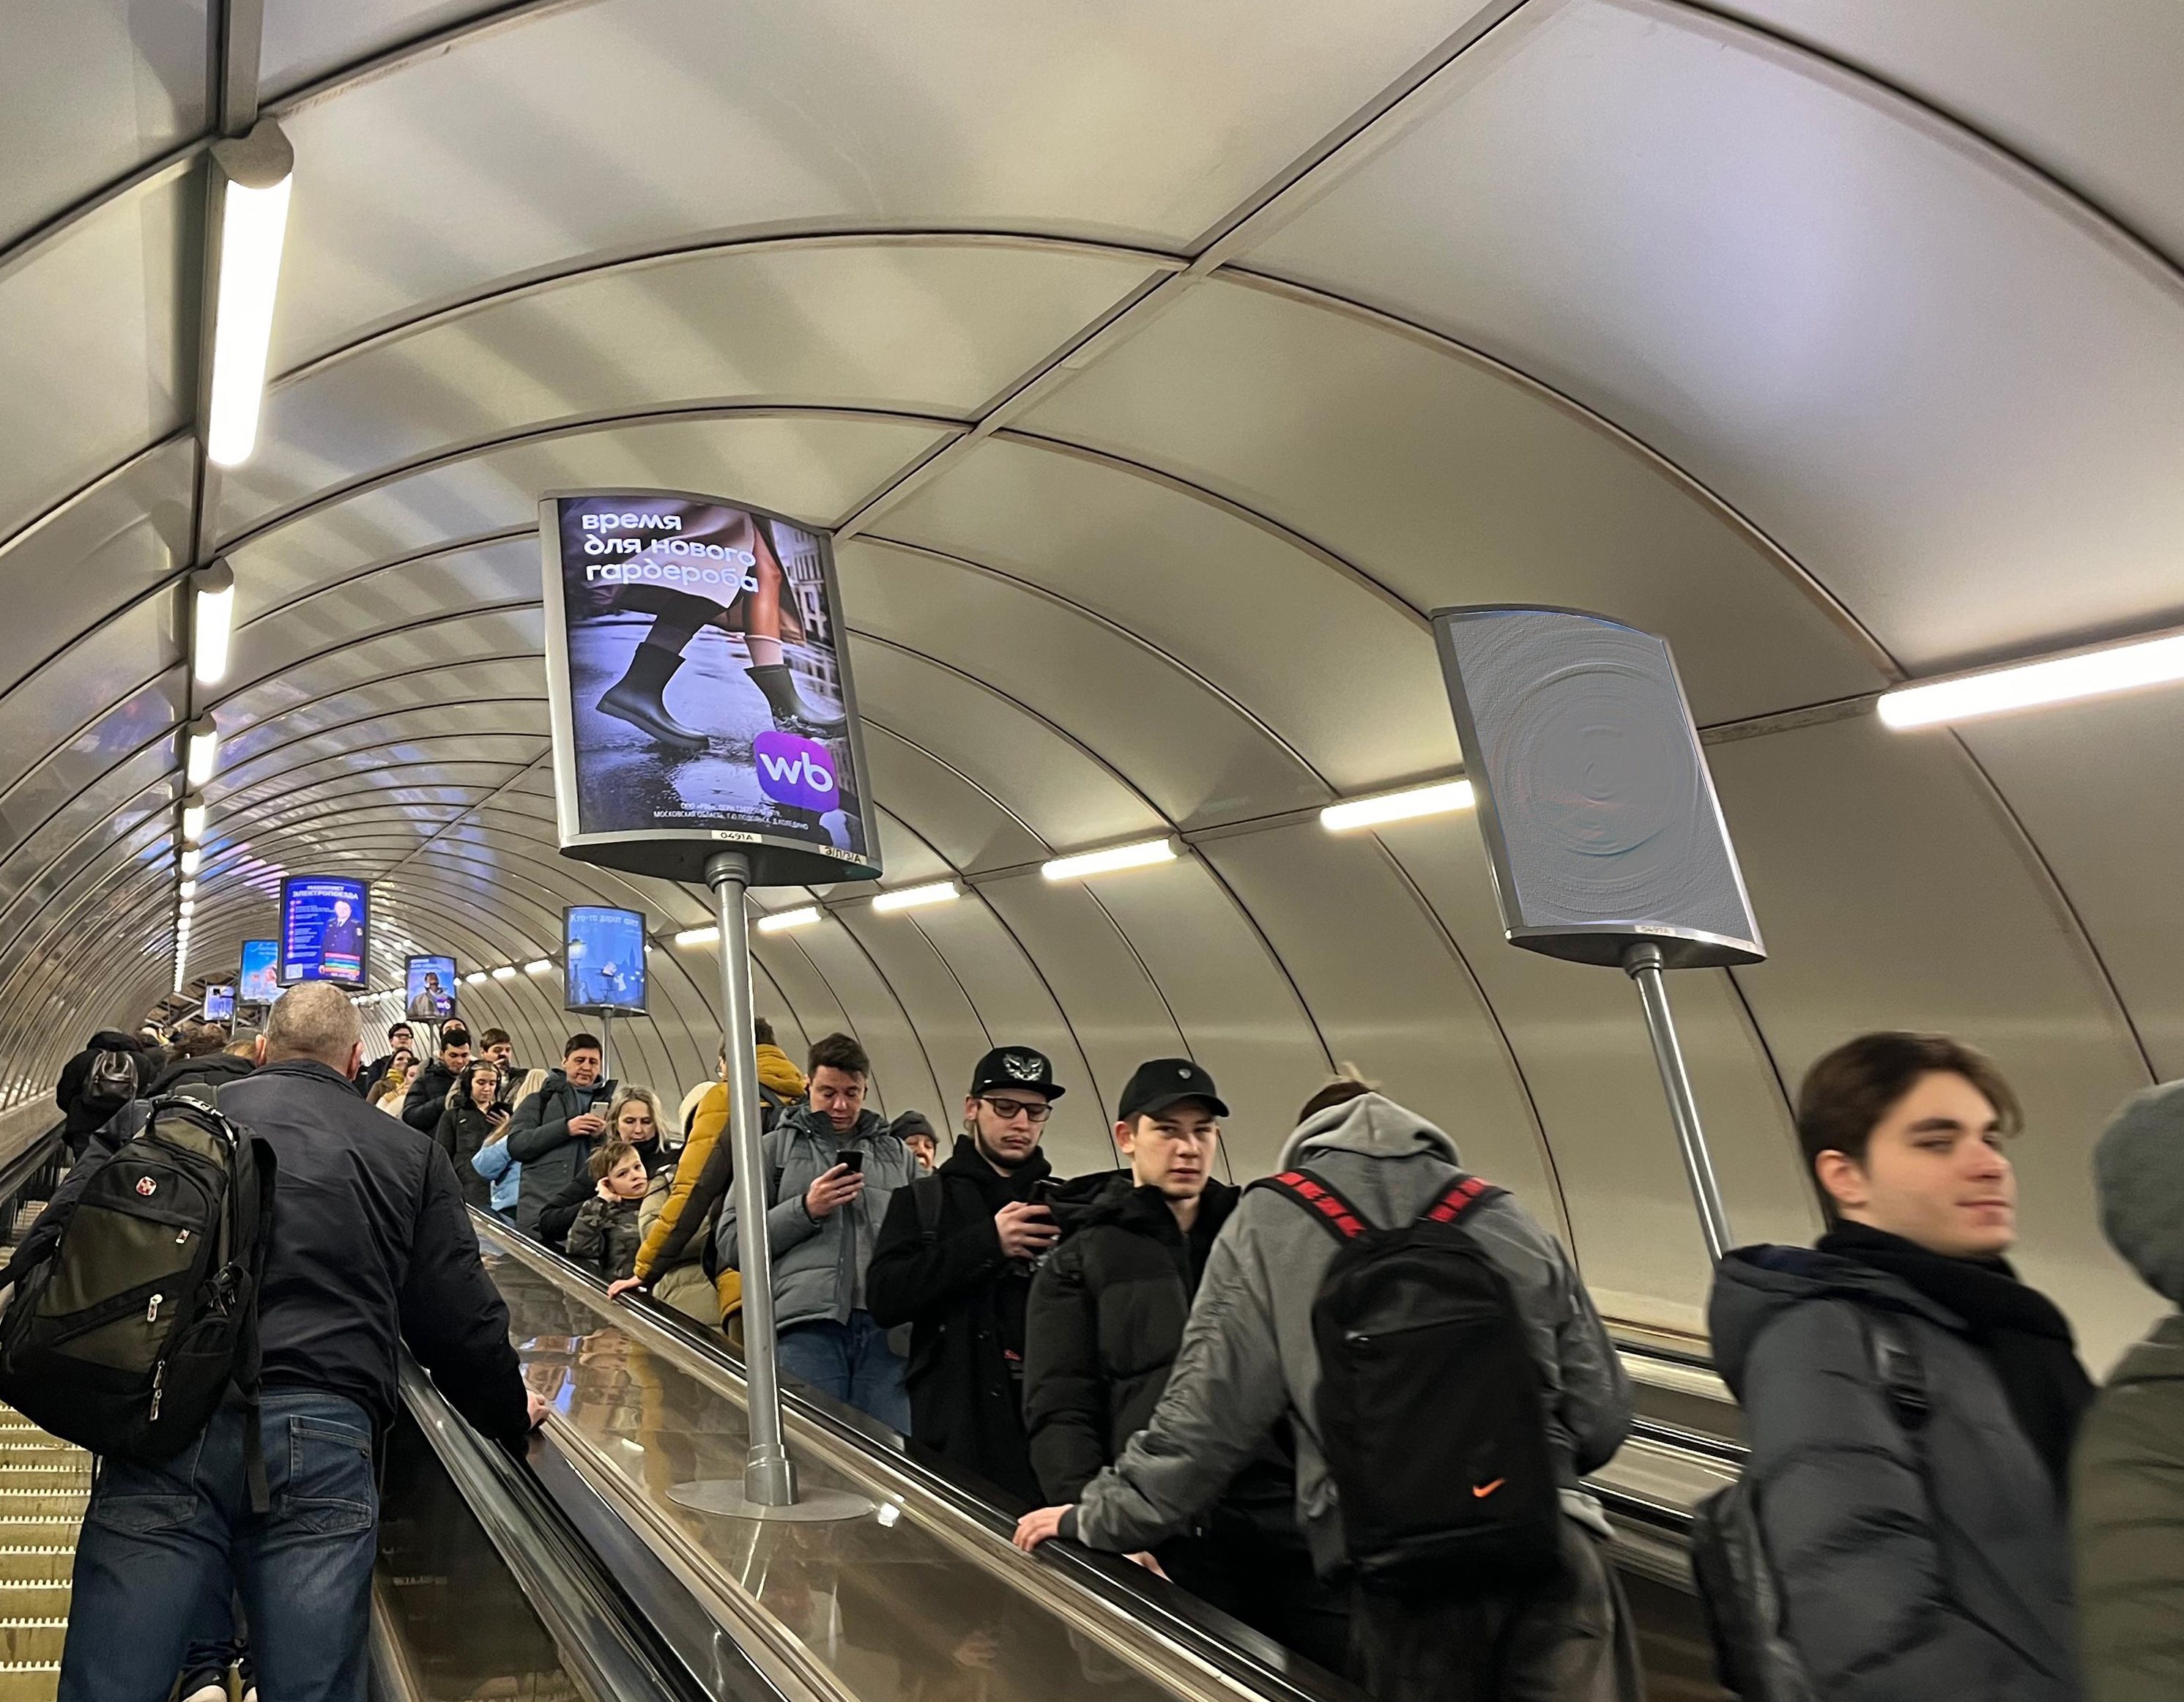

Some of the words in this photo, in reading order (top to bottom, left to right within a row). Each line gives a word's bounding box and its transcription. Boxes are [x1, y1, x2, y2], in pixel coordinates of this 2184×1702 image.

[582, 512, 682, 534] время
[584, 533, 642, 556] для
[650, 539, 757, 568] нового
[585, 559, 759, 593] гардероба
[759, 751, 833, 792] wb
